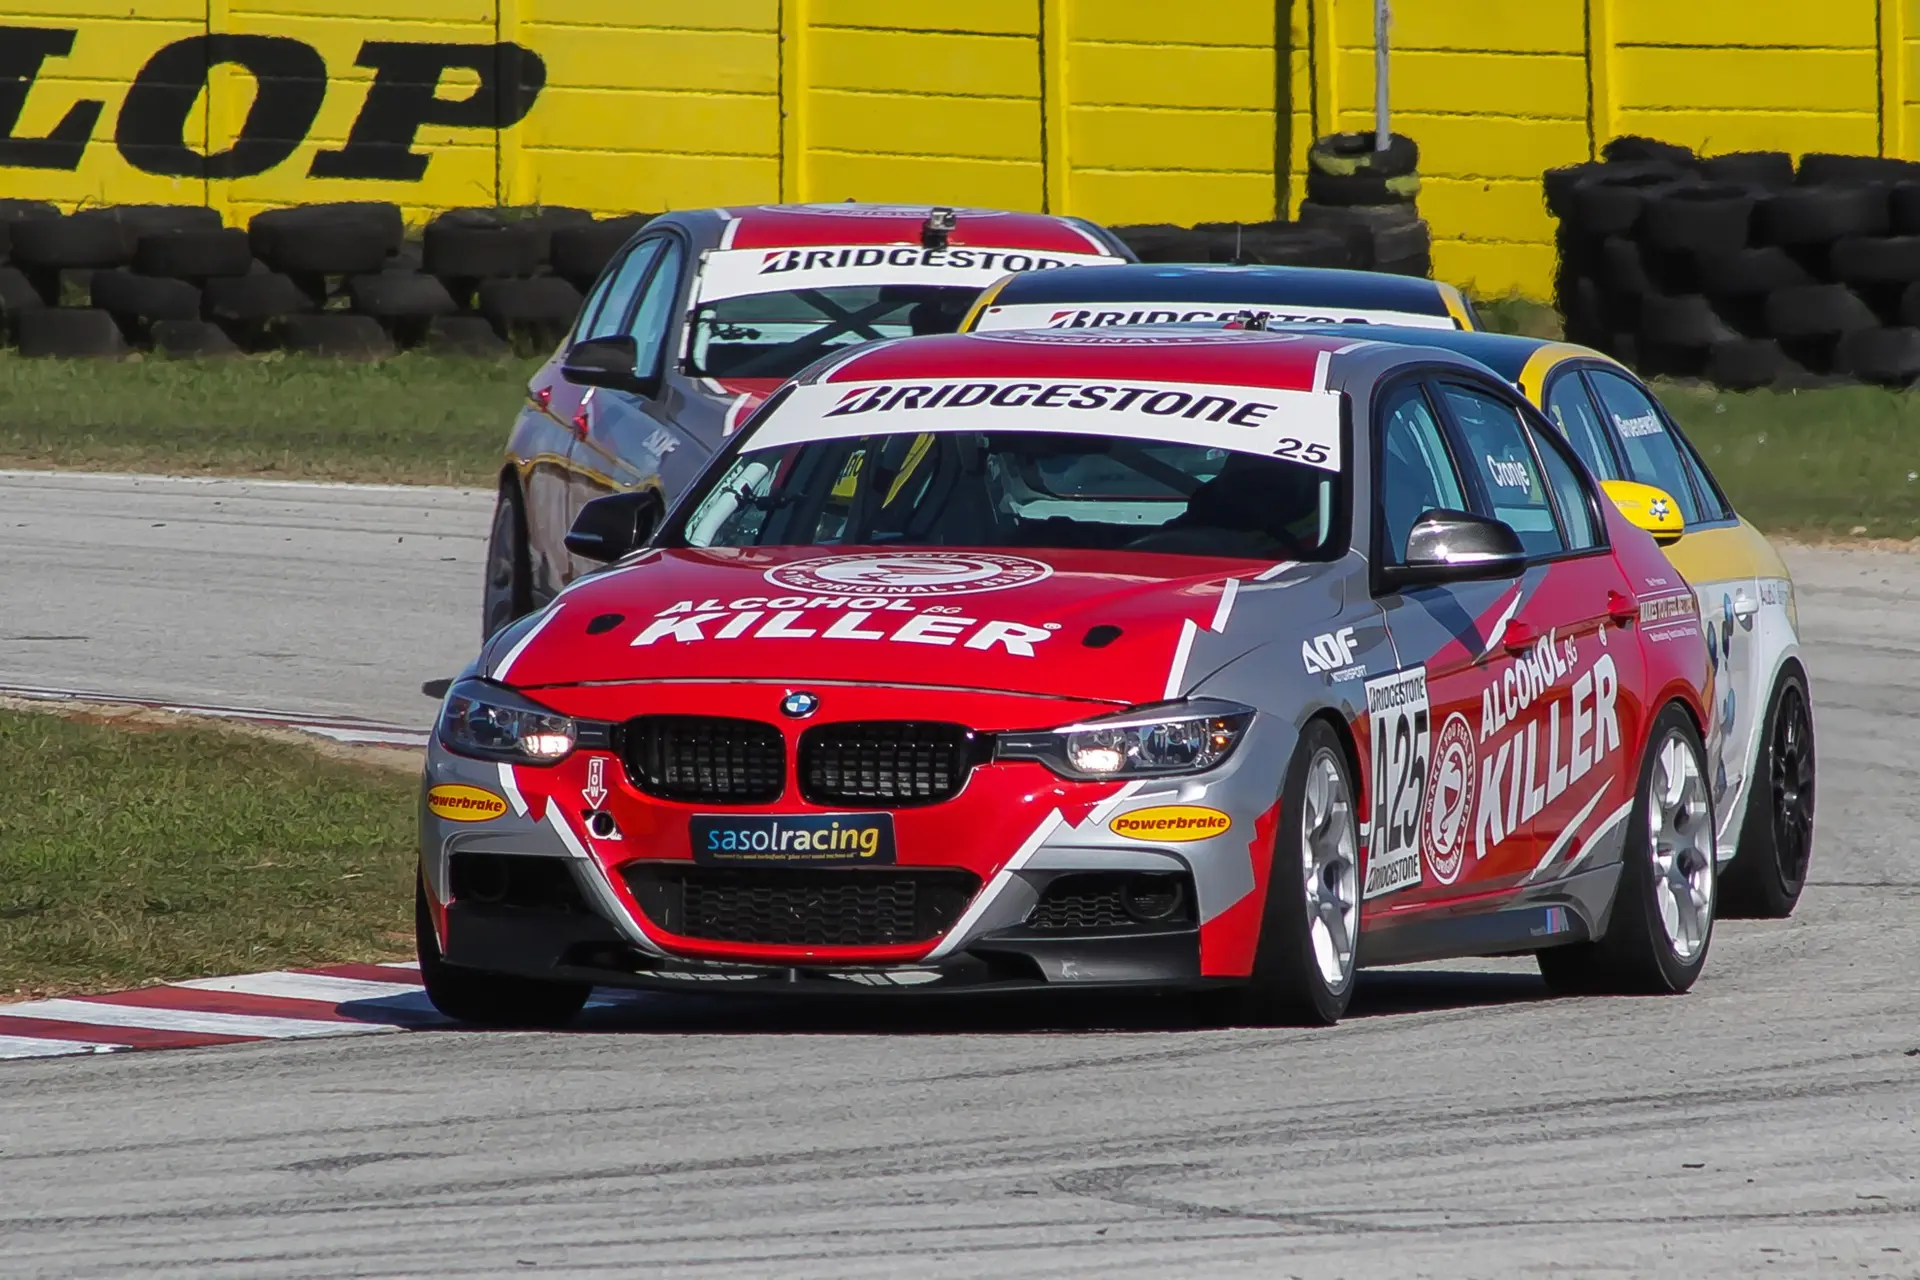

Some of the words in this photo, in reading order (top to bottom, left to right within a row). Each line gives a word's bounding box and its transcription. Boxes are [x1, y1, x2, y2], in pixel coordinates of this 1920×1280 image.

[758, 248, 1084, 275] BRIDGESTO
[1048, 310, 1372, 328] BRIDGTO
[821, 384, 1279, 427] BRIDGESTONE
[1272, 438, 1332, 463] 25
[811, 582, 947, 594] ORIGINAL
[654, 598, 916, 617] ALCOHOL
[630, 611, 1052, 657] KILLER
[1302, 627, 1358, 675] ADF
[1369, 675, 1426, 714] BRIDGESTONE
[1479, 627, 1566, 745] ALCOHOL
[1476, 653, 1621, 861] KILLER
[590, 763, 600, 798] TOW
[1369, 708, 1429, 861] A25
[430, 793, 503, 813] Powerbrake
[707, 822, 881, 857] sasolracing
[1115, 815, 1228, 831] Powerbrake
[1366, 852, 1420, 893] BRIDGESTONE
